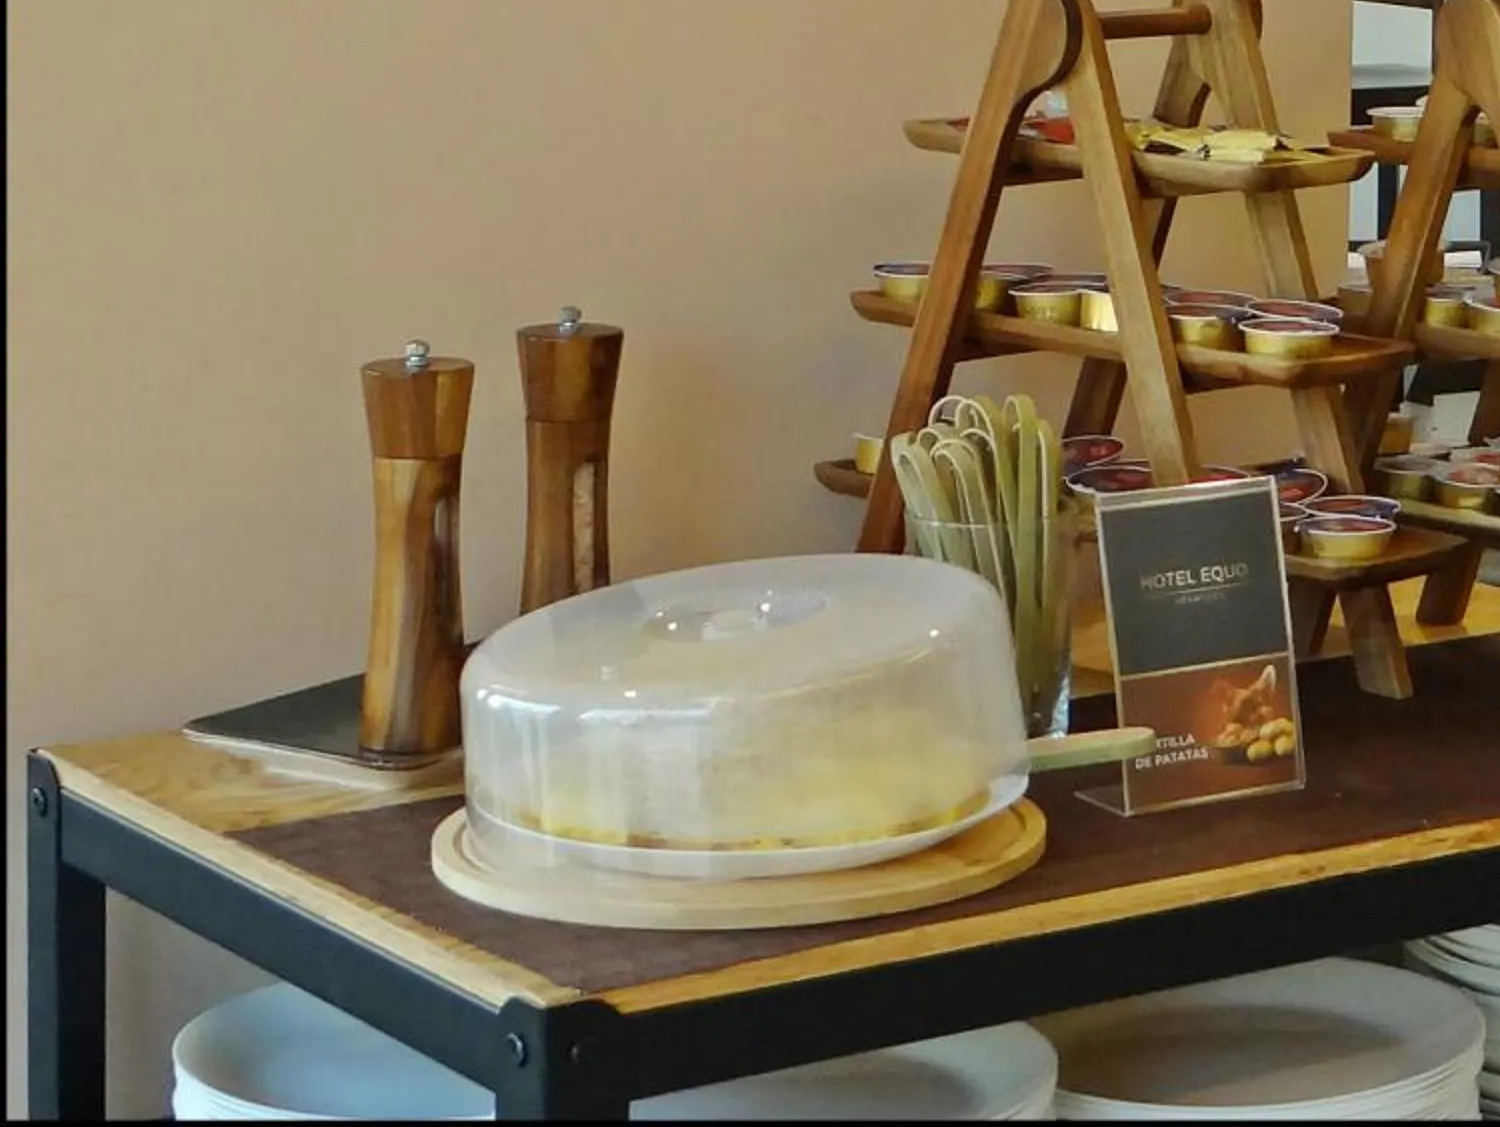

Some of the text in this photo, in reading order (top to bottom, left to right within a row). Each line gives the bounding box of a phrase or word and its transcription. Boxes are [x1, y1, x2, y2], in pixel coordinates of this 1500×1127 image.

[1140, 561, 1249, 591] HOTEL EQUO
[1155, 733, 1196, 749] TILLA
[1135, 747, 1208, 769] DE PATATAS
